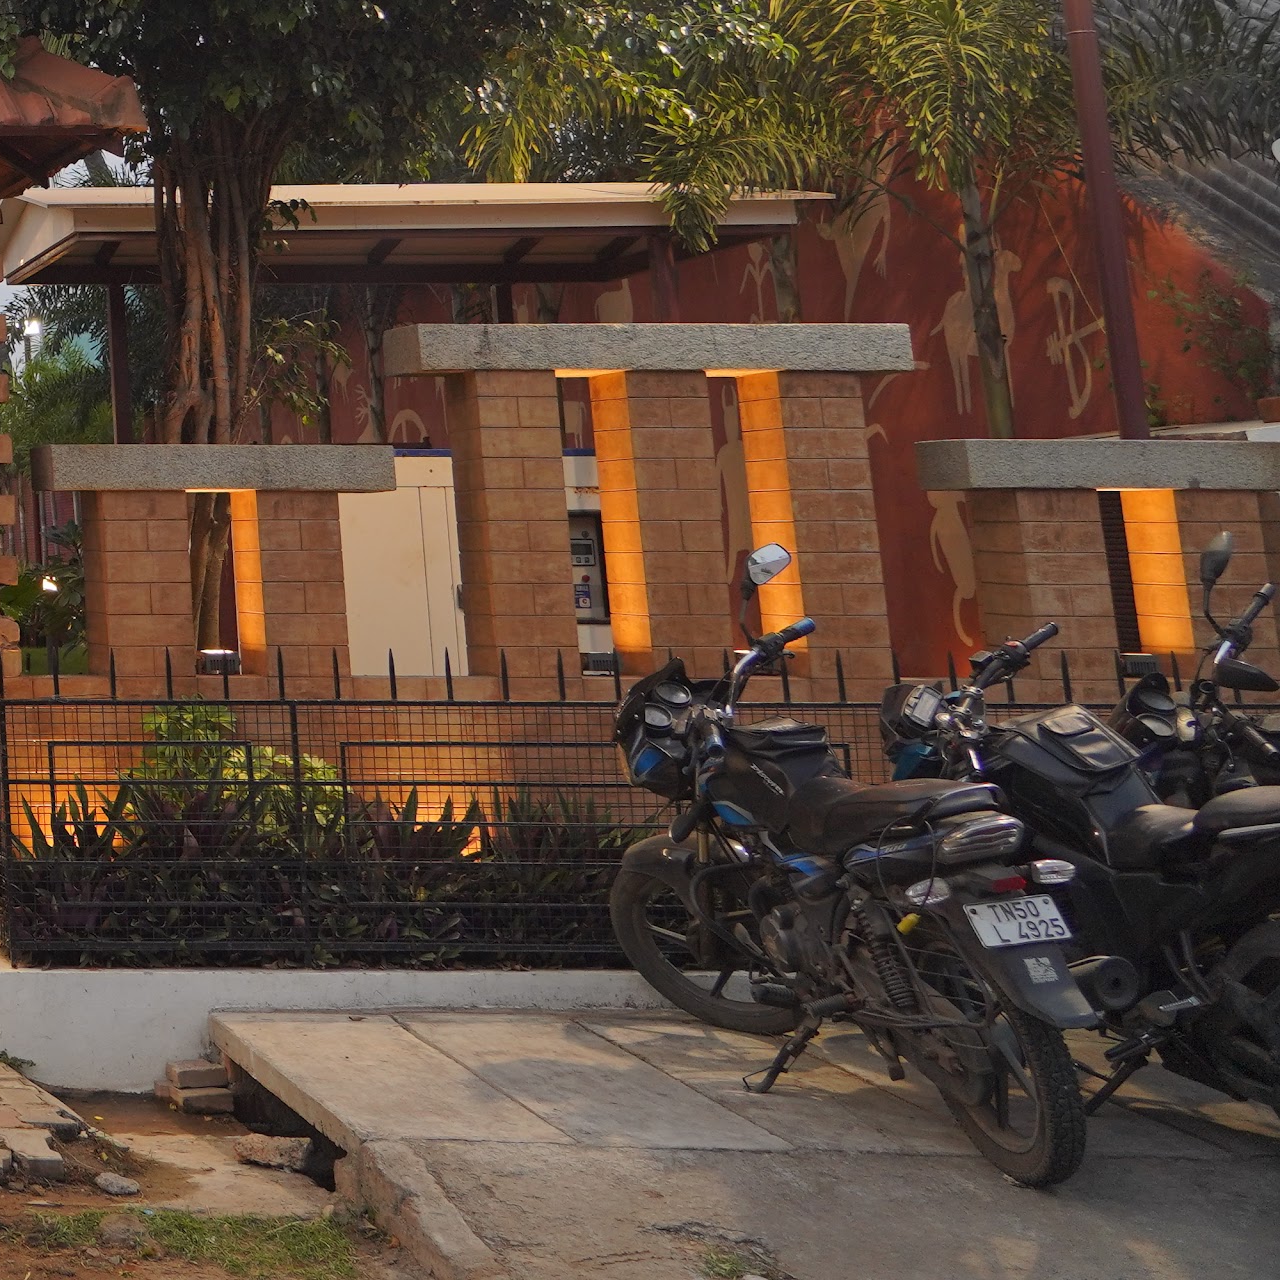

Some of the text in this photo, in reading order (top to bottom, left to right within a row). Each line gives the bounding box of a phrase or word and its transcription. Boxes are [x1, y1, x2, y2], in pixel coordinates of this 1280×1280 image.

[987, 900, 1039, 922] TN50
[992, 917, 1065, 943] L 4925
